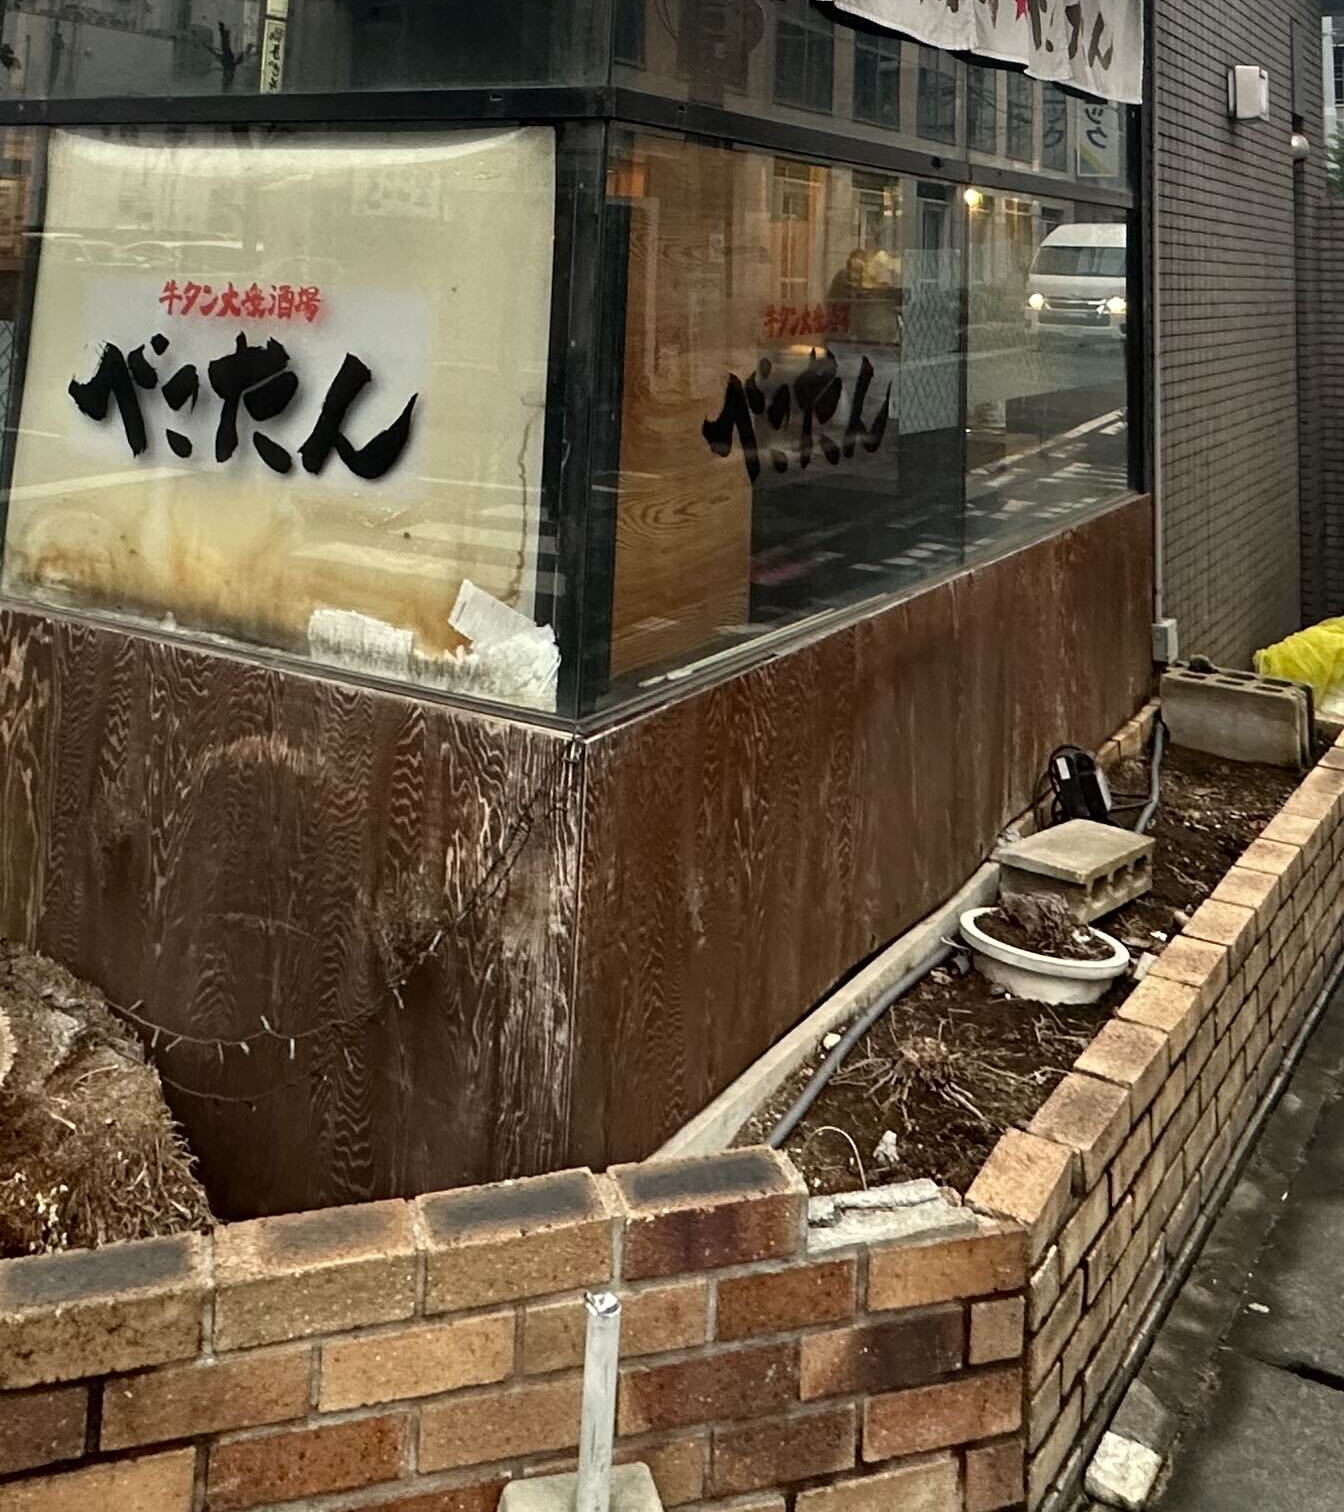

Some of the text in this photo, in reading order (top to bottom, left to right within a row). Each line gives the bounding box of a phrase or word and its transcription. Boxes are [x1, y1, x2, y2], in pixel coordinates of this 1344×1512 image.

[158, 279, 322, 323] 牛タン大衆酒場
[68, 331, 419, 480] べこたん
